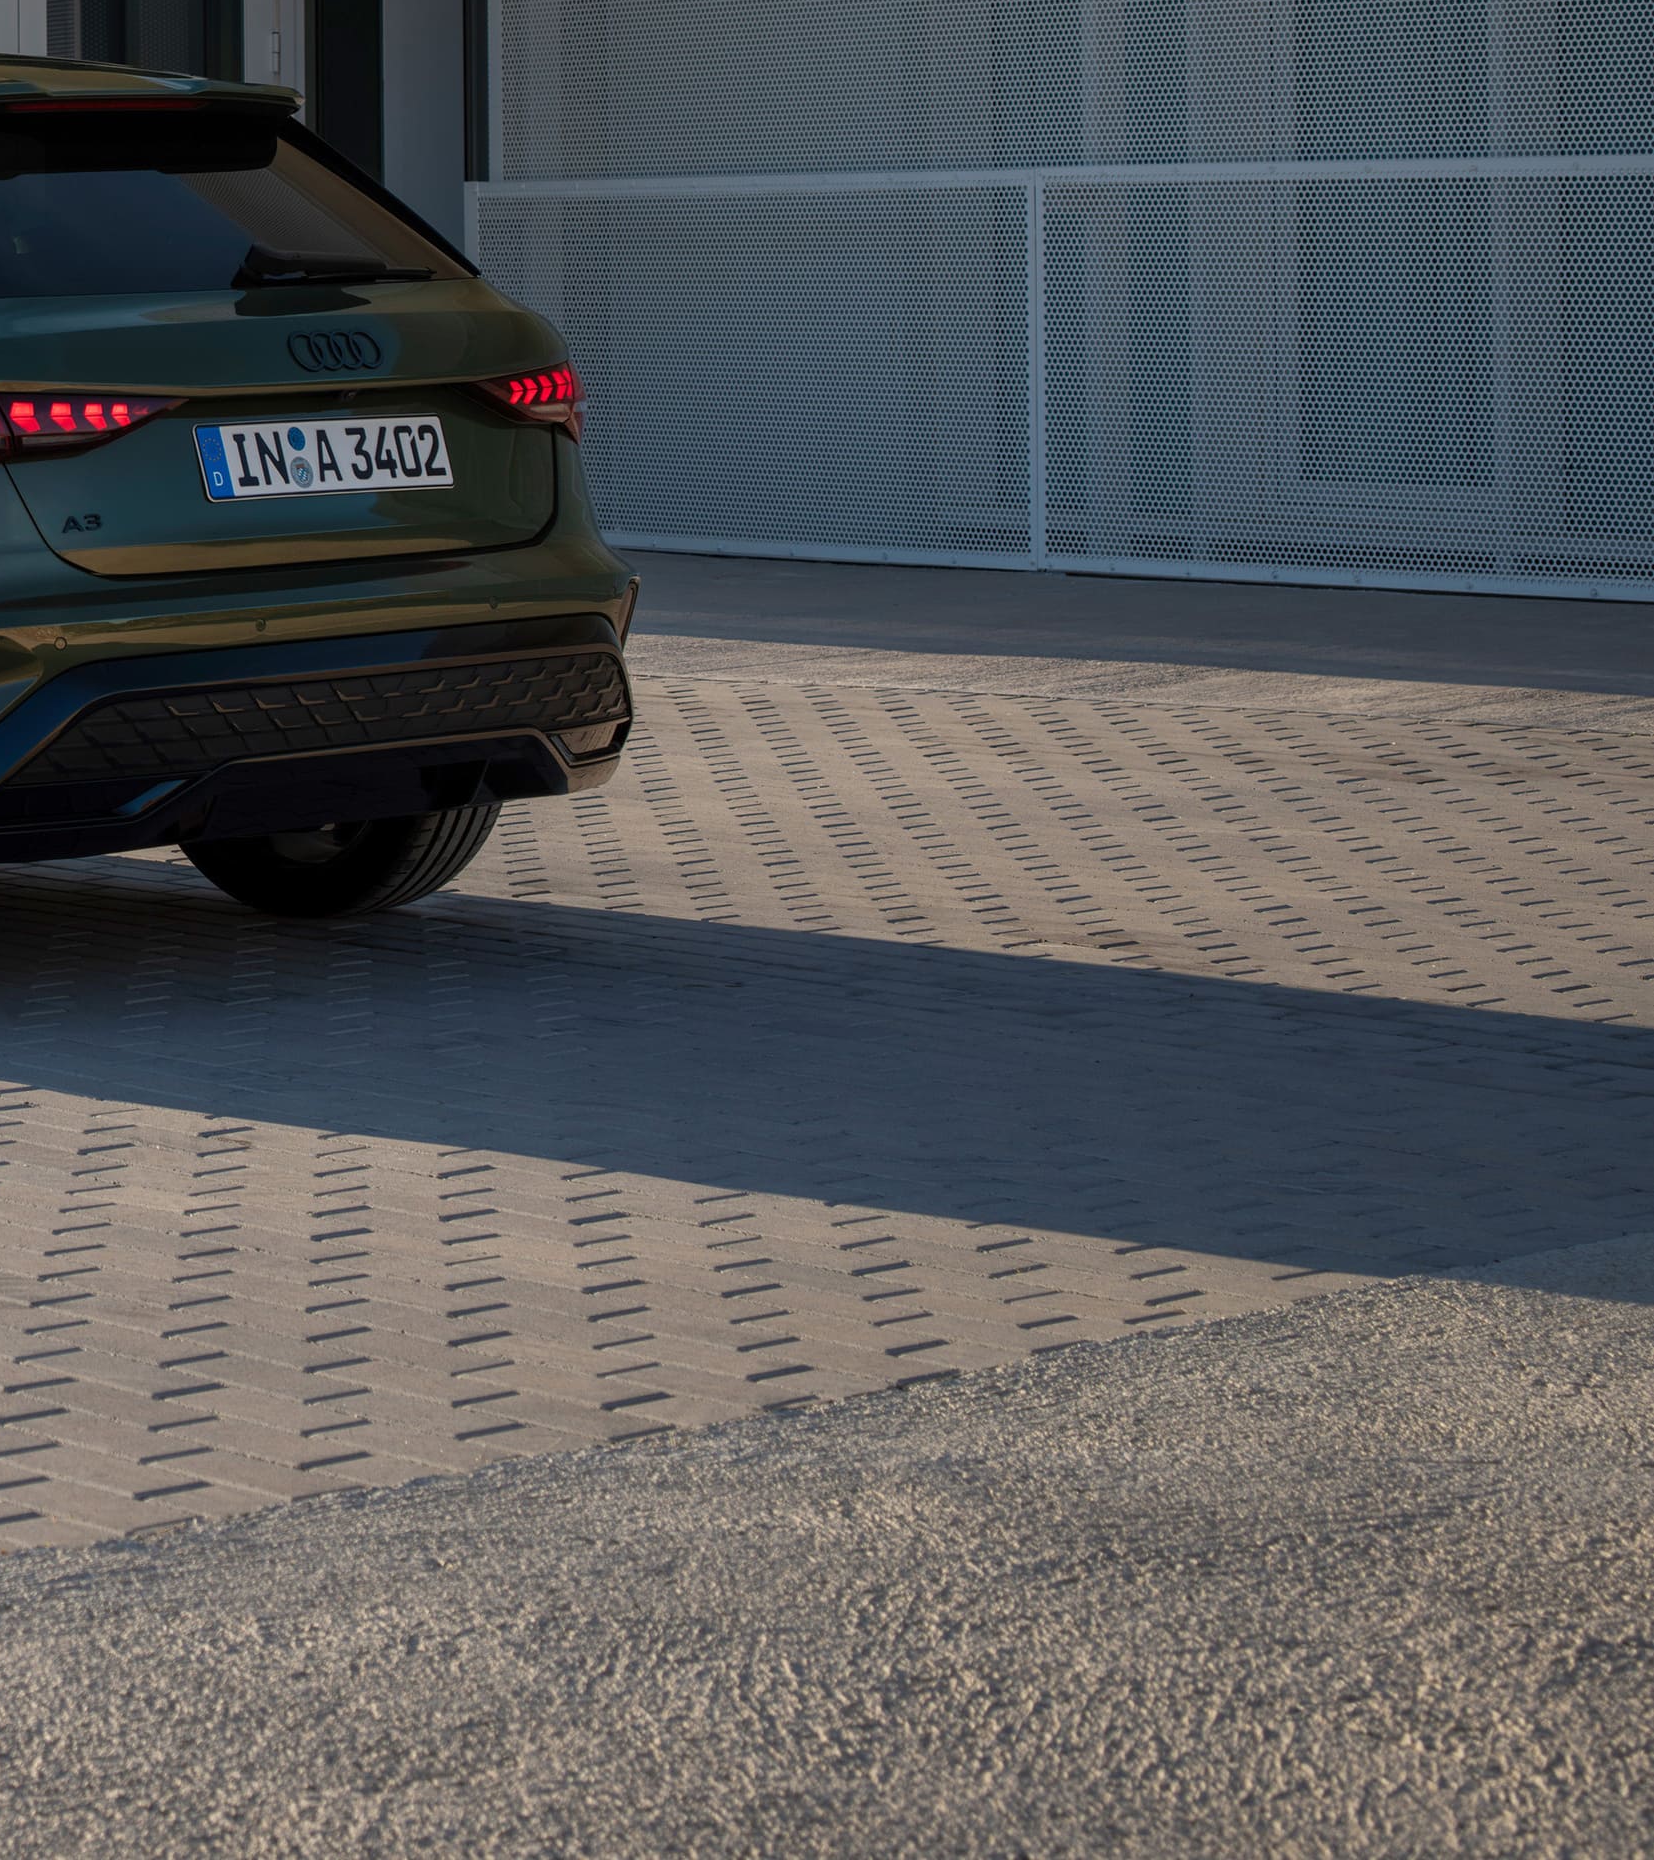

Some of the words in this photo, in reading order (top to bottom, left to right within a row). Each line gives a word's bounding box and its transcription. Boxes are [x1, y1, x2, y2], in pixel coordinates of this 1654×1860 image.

[233, 430, 290, 487] IN
[316, 429, 343, 482] A
[345, 424, 447, 480] 3402
[213, 471, 224, 486] D
[60, 513, 102, 533] A3
